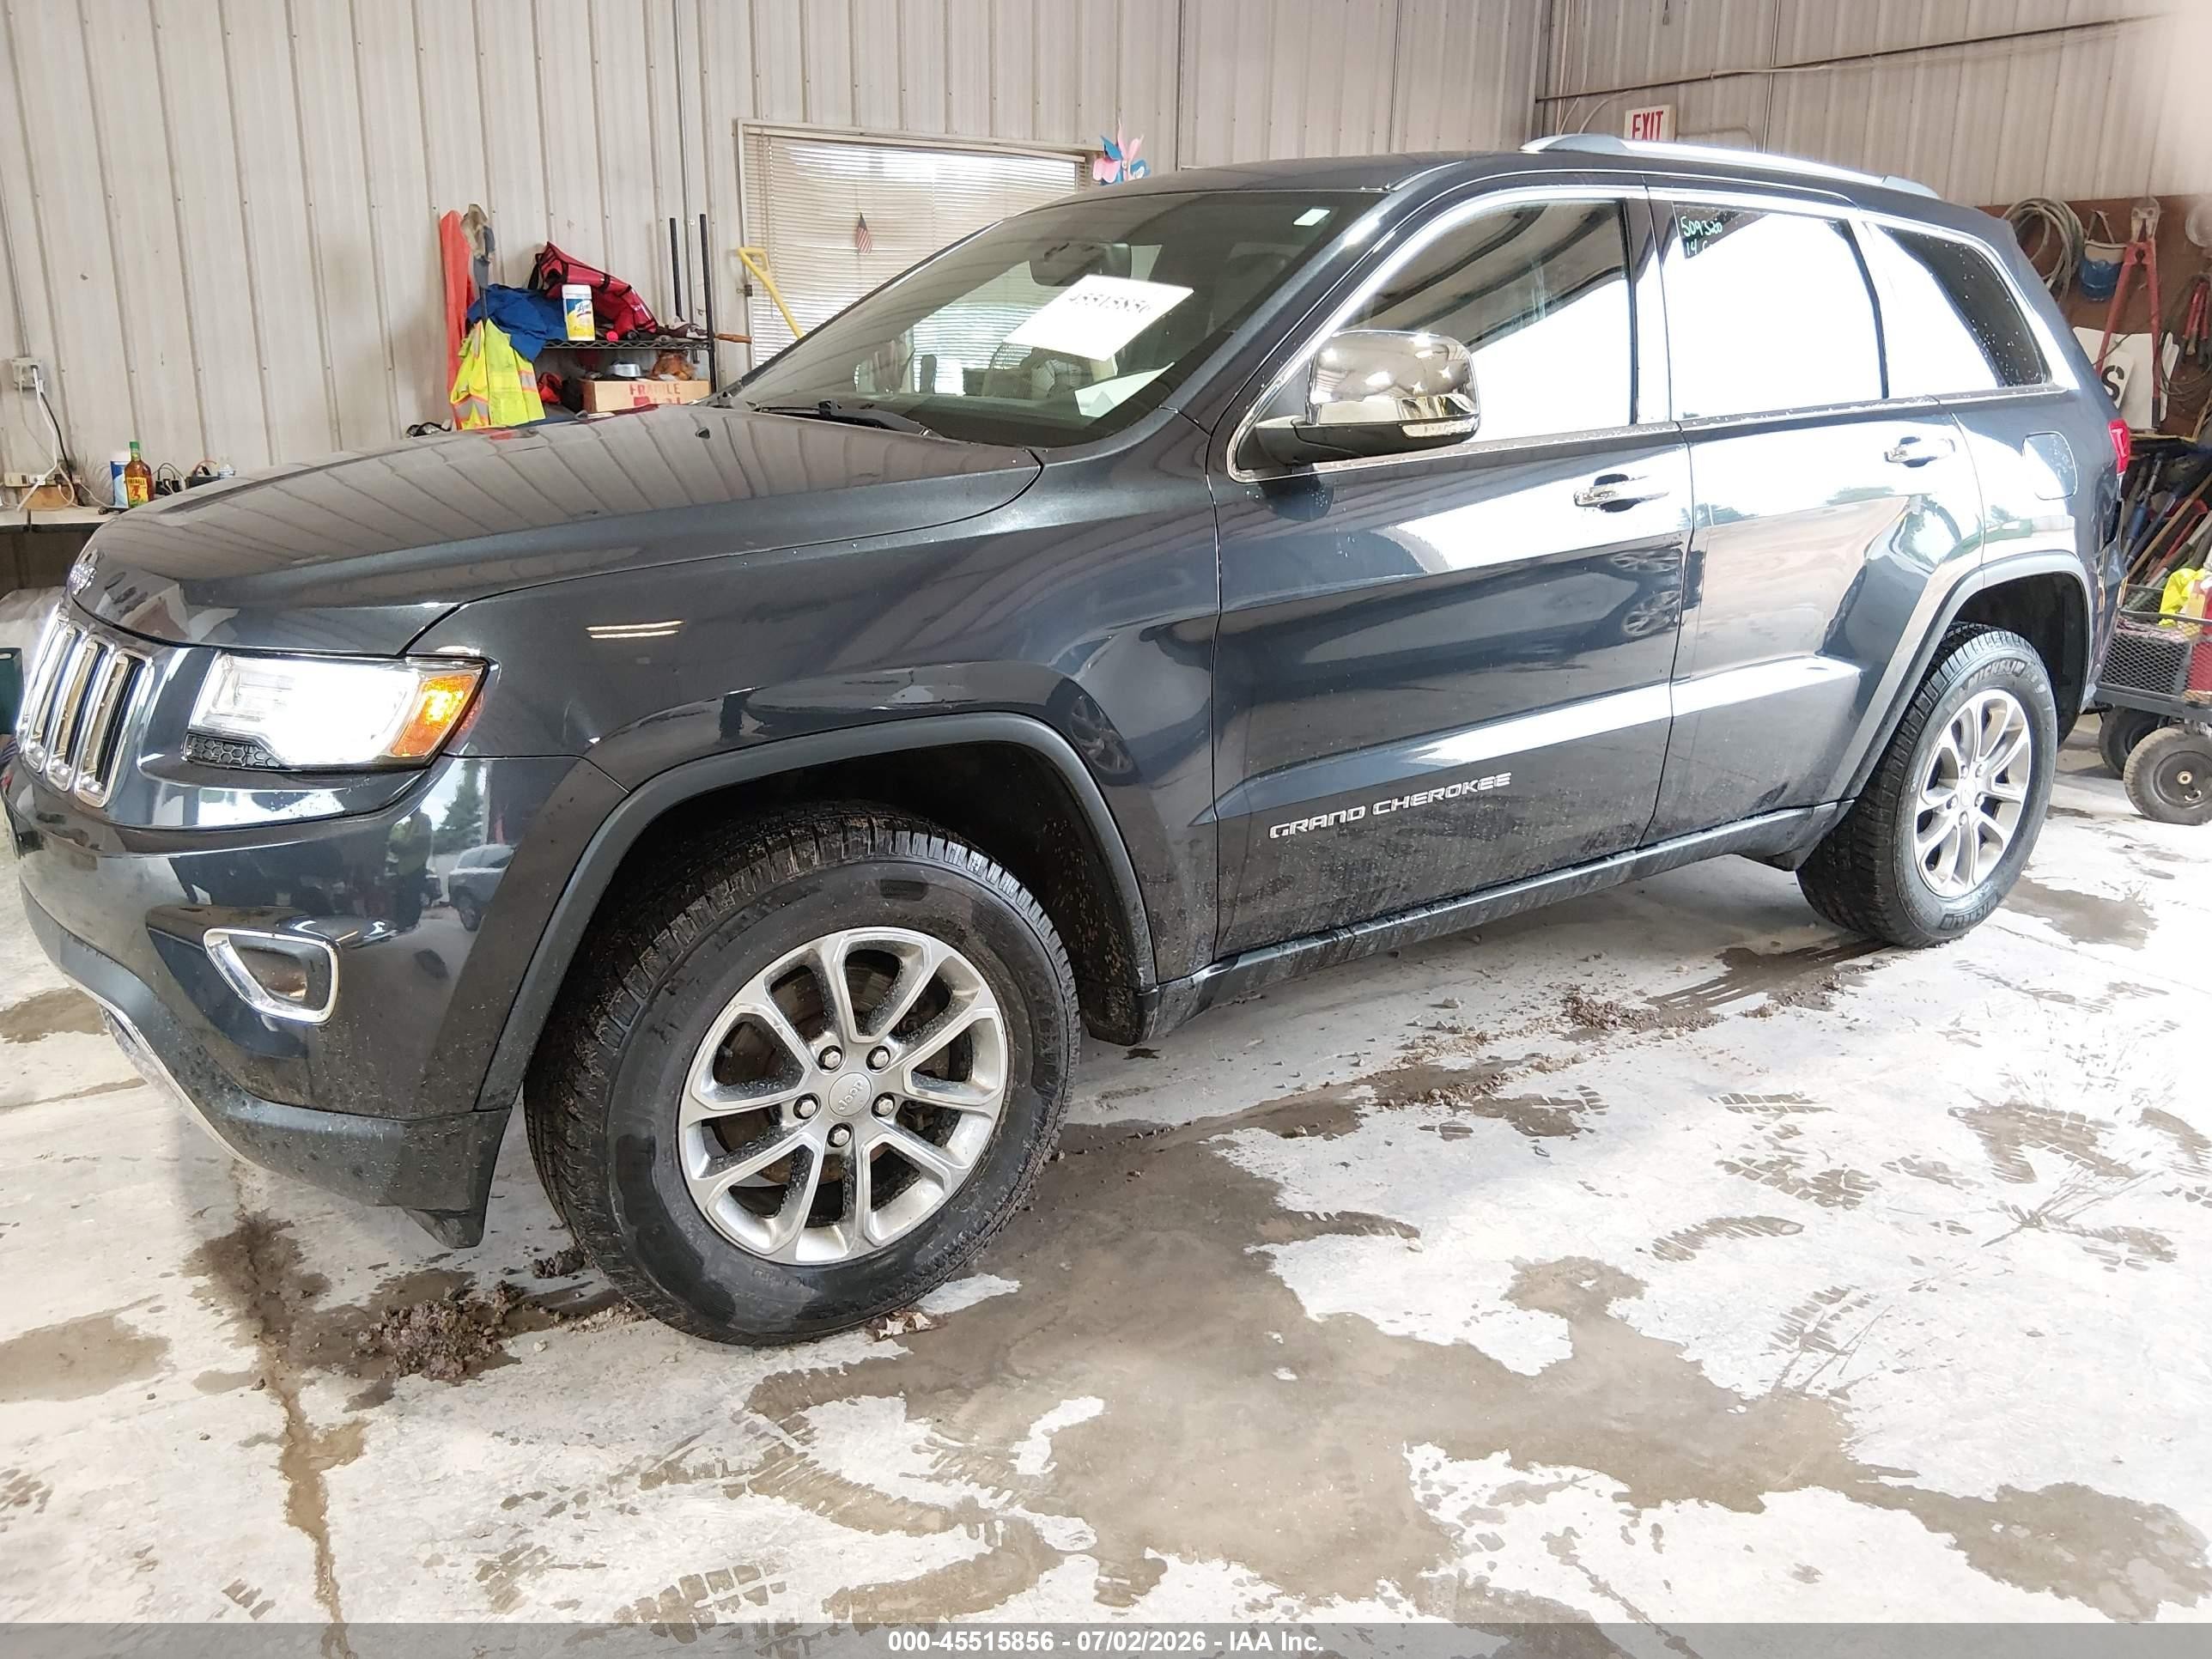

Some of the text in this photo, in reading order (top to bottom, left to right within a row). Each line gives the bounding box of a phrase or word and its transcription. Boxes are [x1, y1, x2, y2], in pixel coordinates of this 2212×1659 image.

[1632, 111, 1663, 140] EXIT
[629, 384, 681, 396] FRLE
[2101, 365, 2124, 401] S
[1269, 772, 1511, 839] GRAND CHEROKEE
[838, 1080, 864, 1110] Jeep
